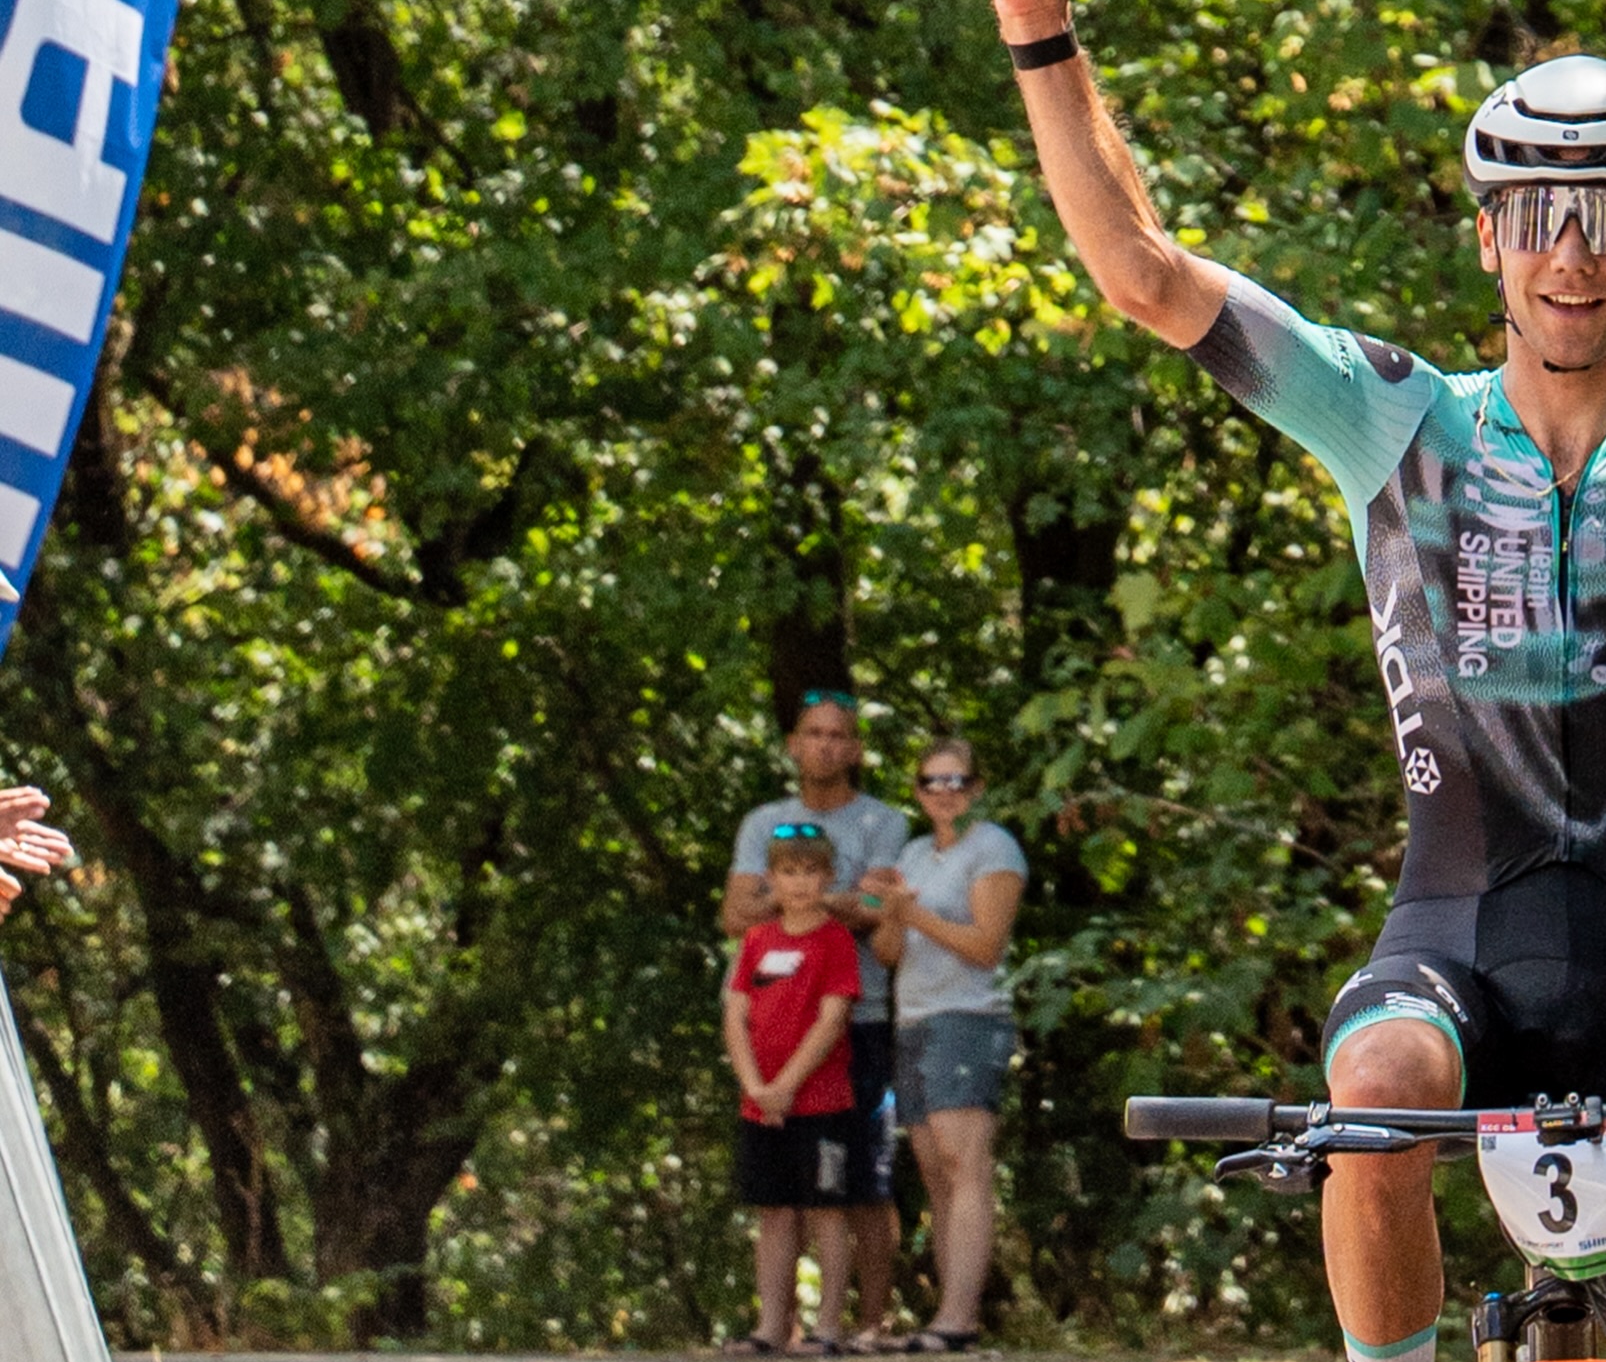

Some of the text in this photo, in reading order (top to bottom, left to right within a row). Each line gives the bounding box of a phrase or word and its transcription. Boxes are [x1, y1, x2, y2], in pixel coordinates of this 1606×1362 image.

[1457, 531, 1491, 677] SHIPPING
[1490, 538, 1527, 648] UNITED
[1527, 544, 1553, 608] Team
[1532, 1152, 1579, 1234] 3
